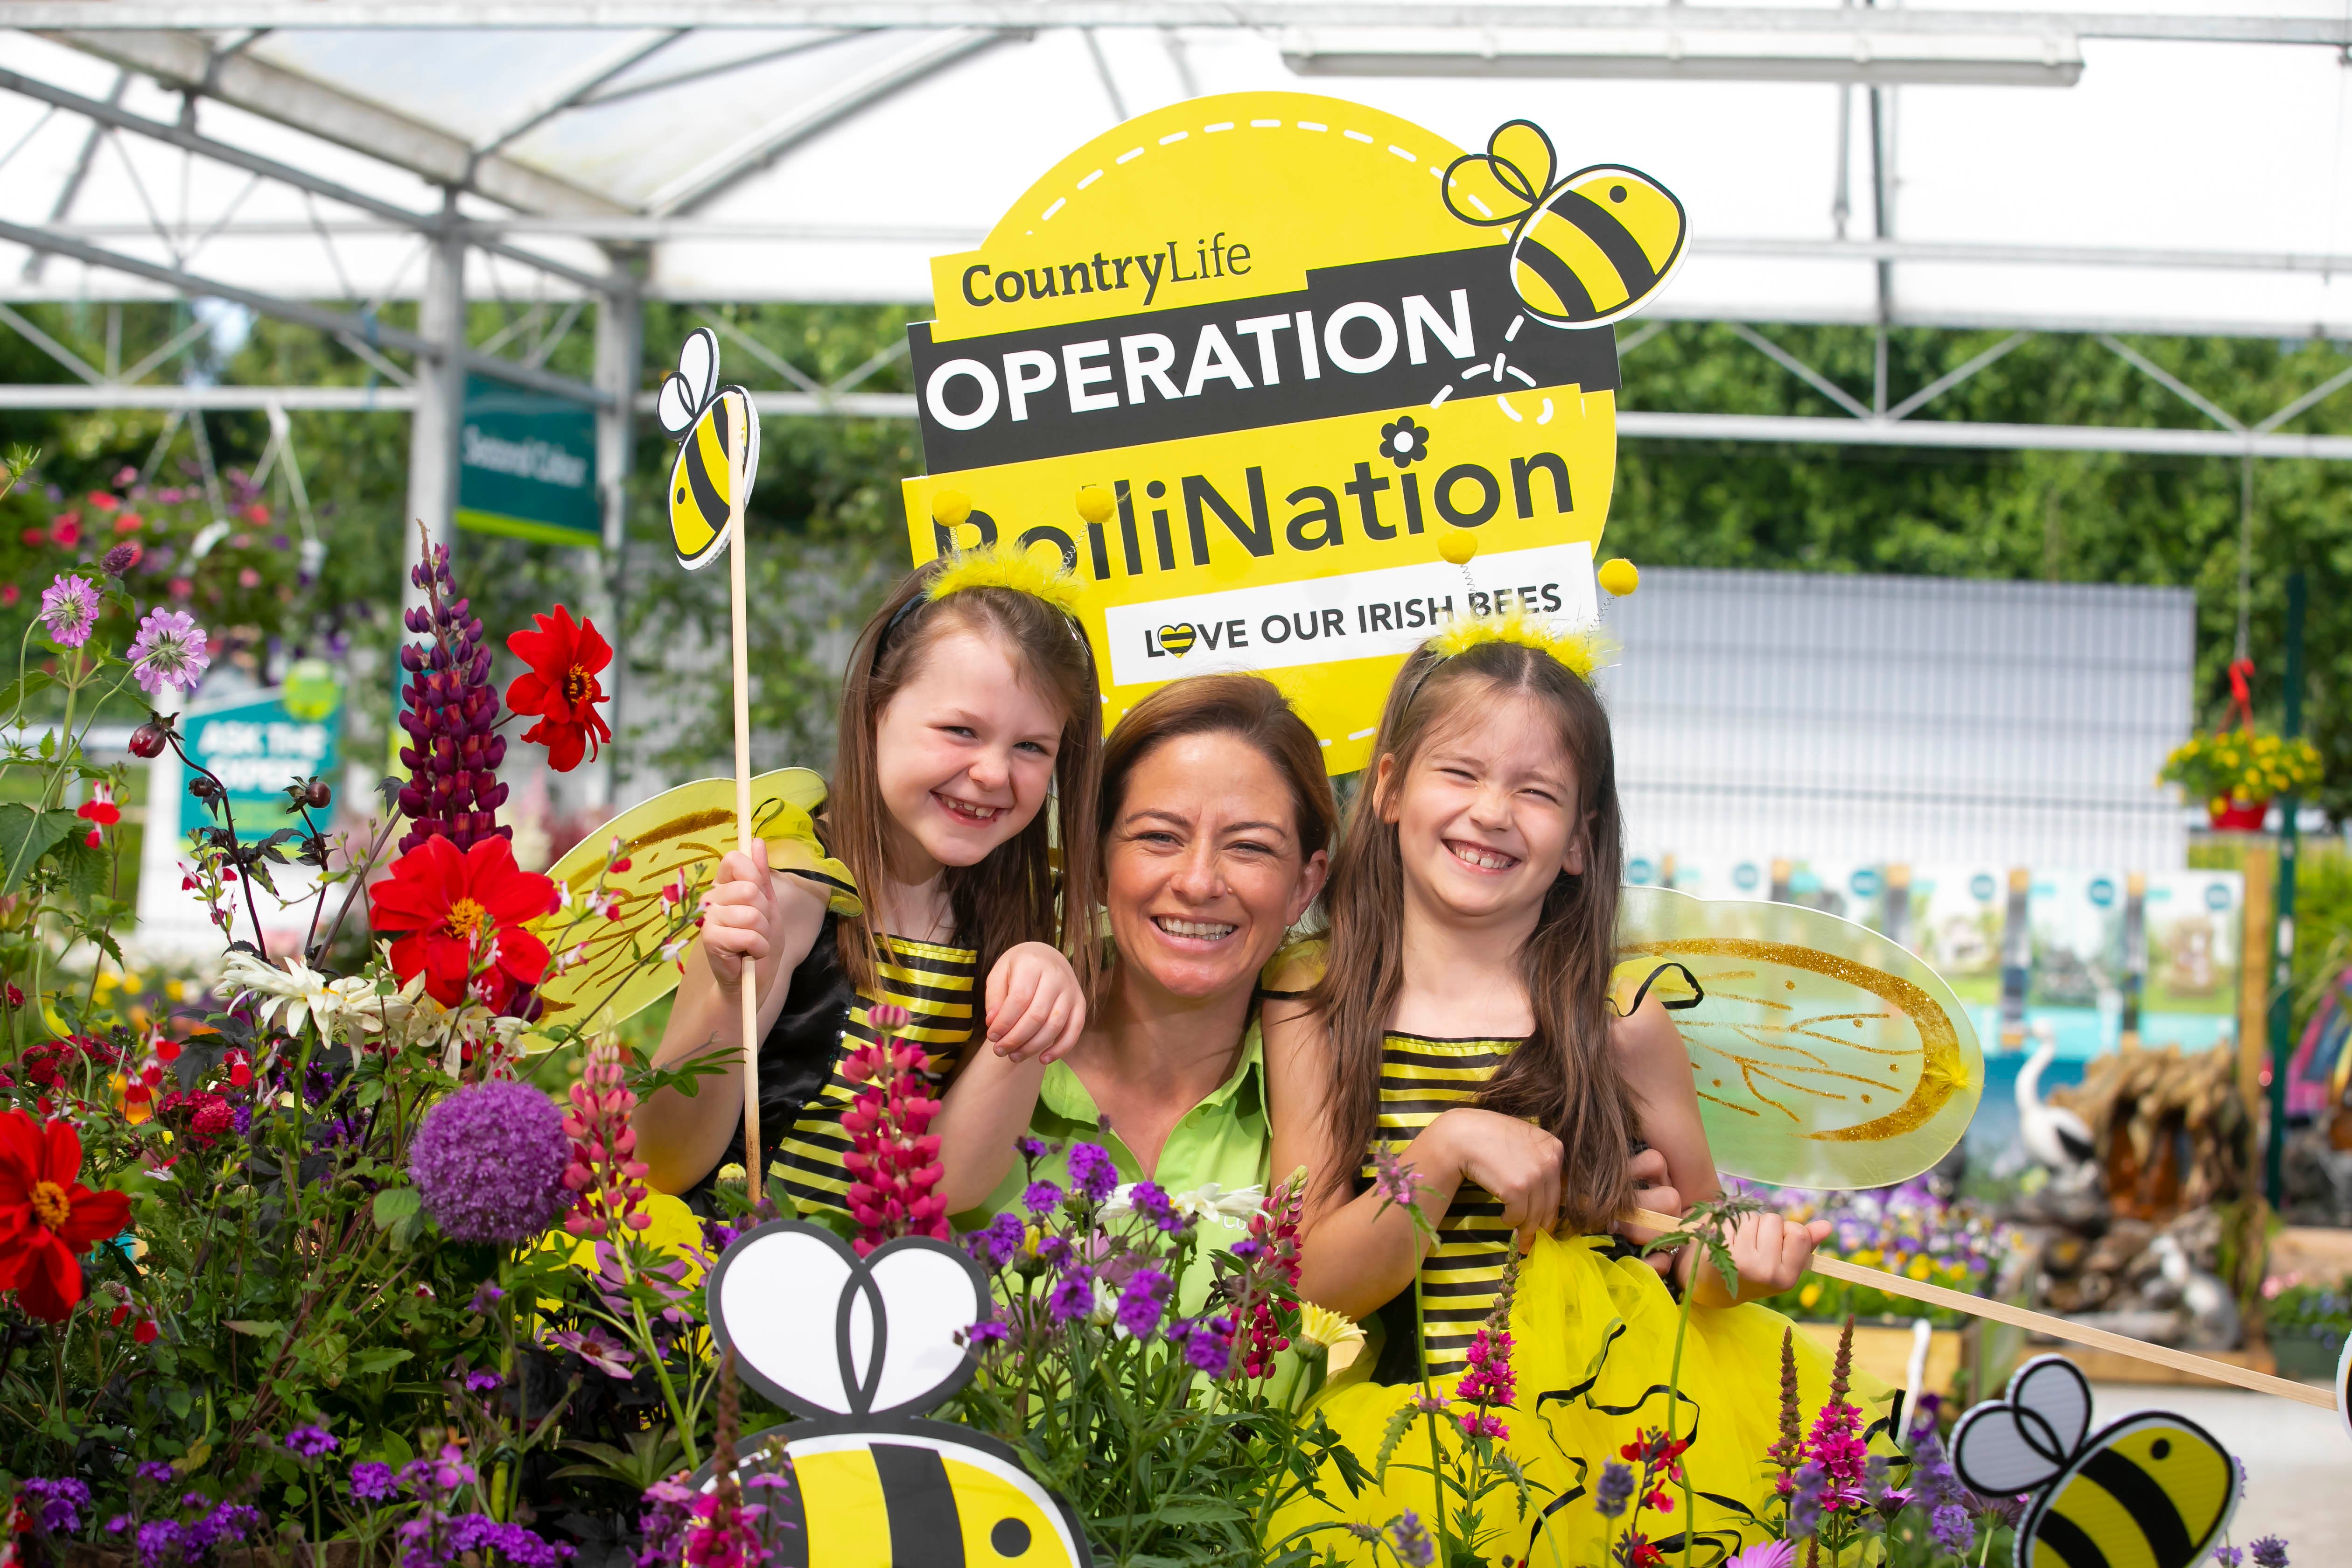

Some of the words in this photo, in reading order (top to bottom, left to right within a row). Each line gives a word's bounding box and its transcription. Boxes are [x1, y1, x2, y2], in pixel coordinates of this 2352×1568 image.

[962, 232, 1252, 307] CountryLife
[926, 288, 1477, 431] OPERATION
[1261, 608, 1344, 644] OUR
[1358, 595, 1454, 634] IRISH
[1468, 583, 1562, 620] BEES
[196, 720, 265, 756] ASK
[266, 721, 328, 760] THE
